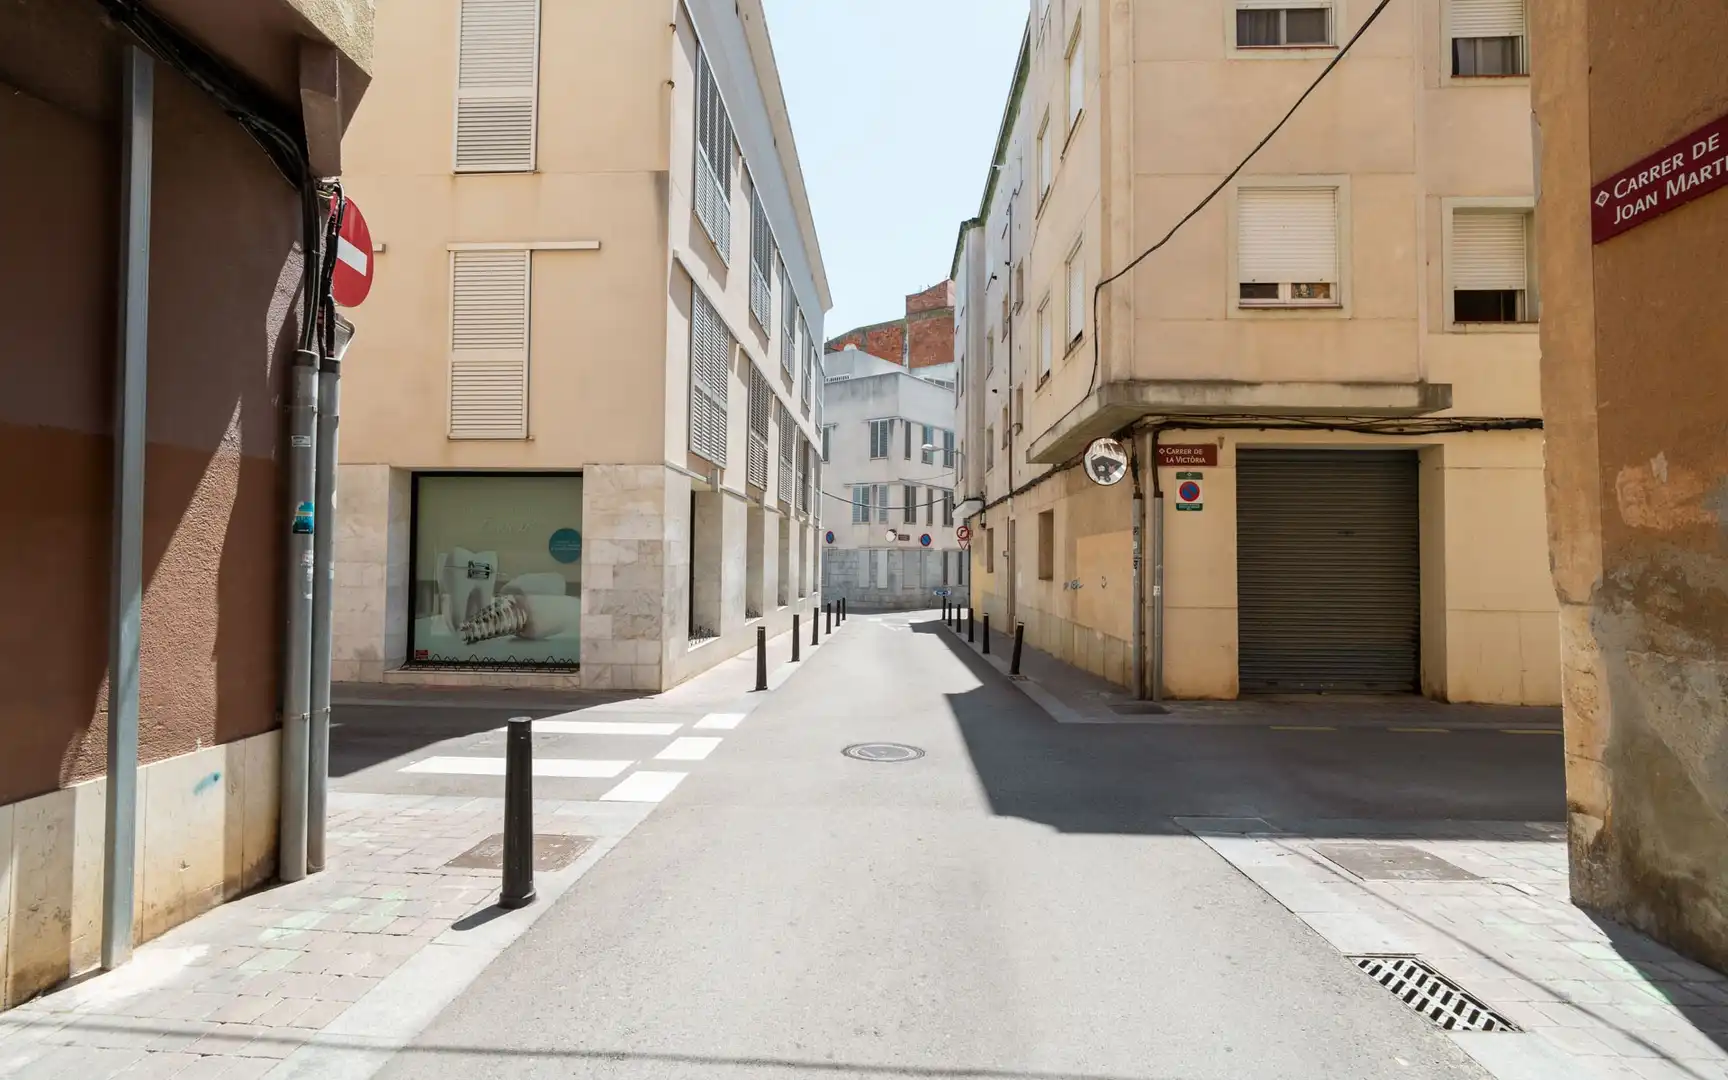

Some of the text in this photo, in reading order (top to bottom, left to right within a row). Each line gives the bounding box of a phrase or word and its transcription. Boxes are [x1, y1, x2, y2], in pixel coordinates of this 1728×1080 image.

[1613, 132, 1720, 199] CARRER DE
[1613, 191, 1658, 225] JOAN
[1166, 447, 1192, 455] CARRER
[1175, 455, 1206, 463] VICTÒRIA
